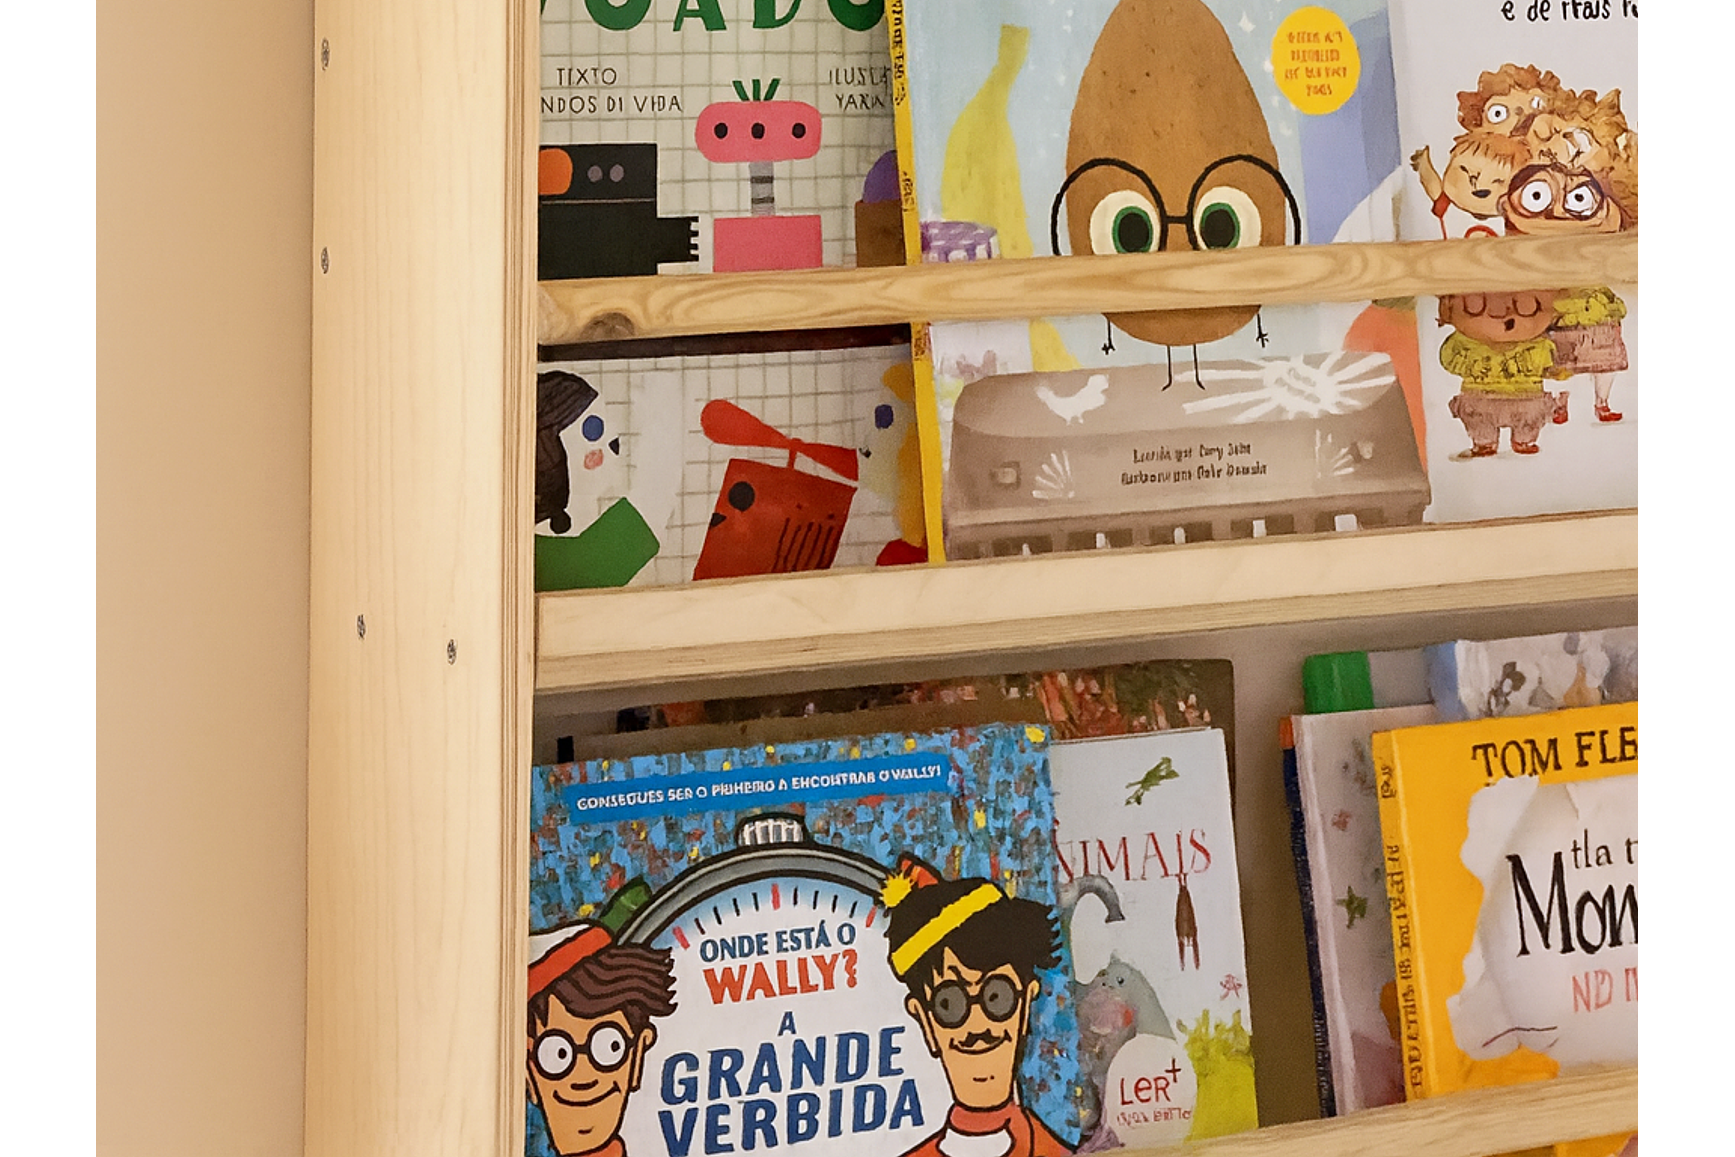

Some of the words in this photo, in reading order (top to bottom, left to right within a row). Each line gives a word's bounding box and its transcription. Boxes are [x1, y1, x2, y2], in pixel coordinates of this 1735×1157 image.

[1501, 0, 1515, 21] e
[1471, 738, 1562, 786] TOM
[700, 932, 769, 963] ONDE
[775, 919, 832, 953] ESTÁ
[837, 922, 856, 945] O
[702, 948, 858, 1005] WALLY?
[777, 1011, 797, 1036] A
[661, 1026, 906, 1104] GRANDE
[658, 1079, 925, 1157] VERBIDA
